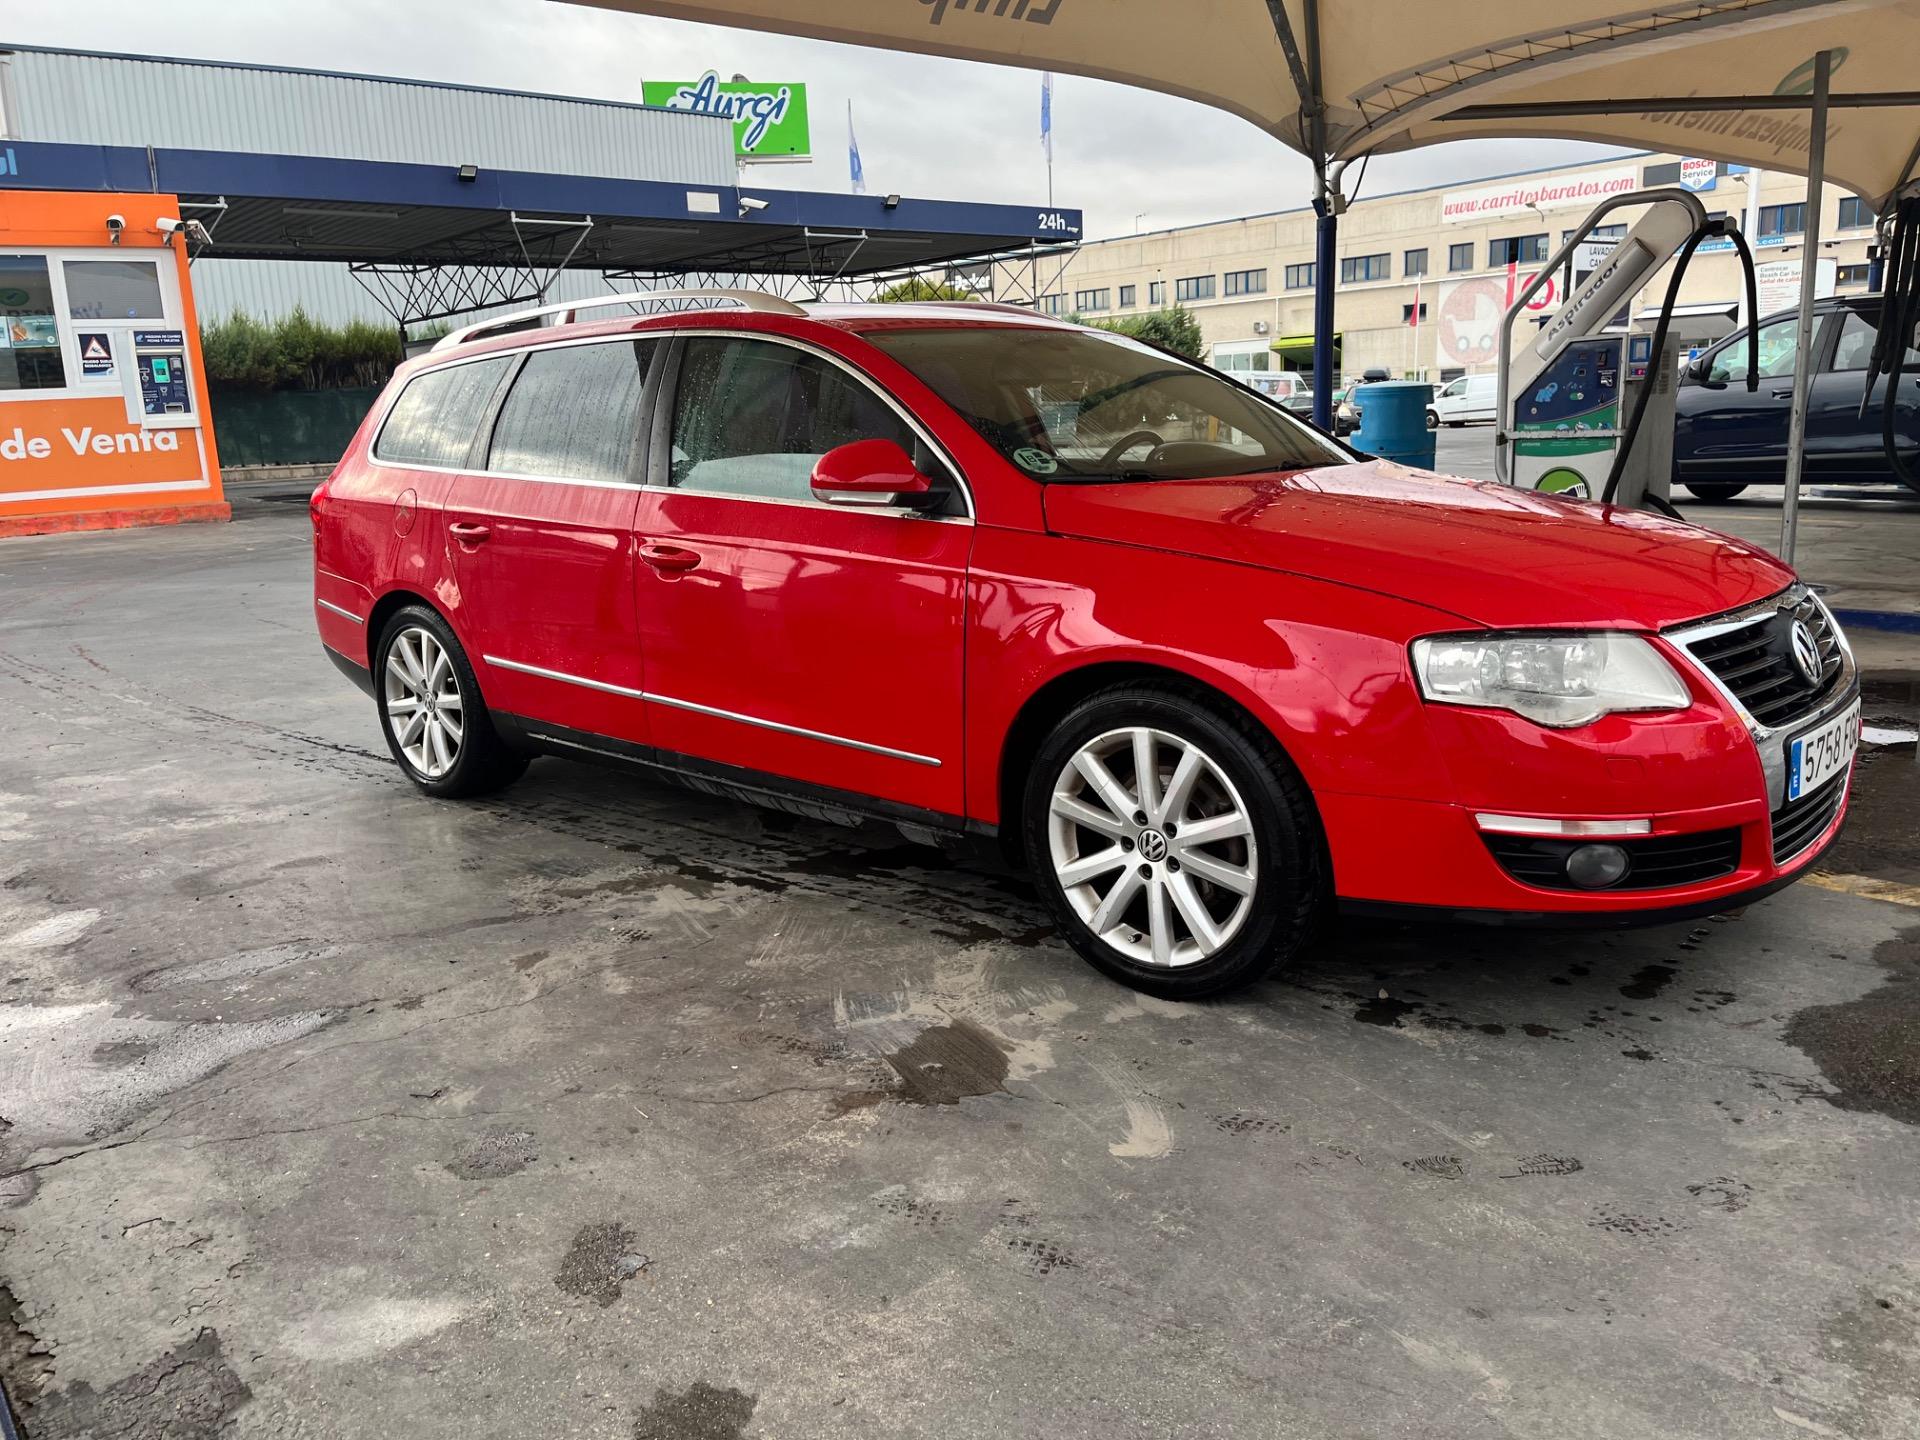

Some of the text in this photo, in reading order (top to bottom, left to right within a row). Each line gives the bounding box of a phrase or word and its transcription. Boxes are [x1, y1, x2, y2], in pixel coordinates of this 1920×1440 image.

[672, 74, 789, 149] Aurgi
[1682, 169, 1714, 179] Service
[1683, 160, 1714, 171] BOSCH
[1443, 176, 1635, 216] www.carritosbaratos.com
[1038, 212, 1066, 230] 24h
[1548, 258, 1619, 341] Aspirador
[0, 426, 178, 461] de Venta
[1805, 724, 1842, 783] 5758
